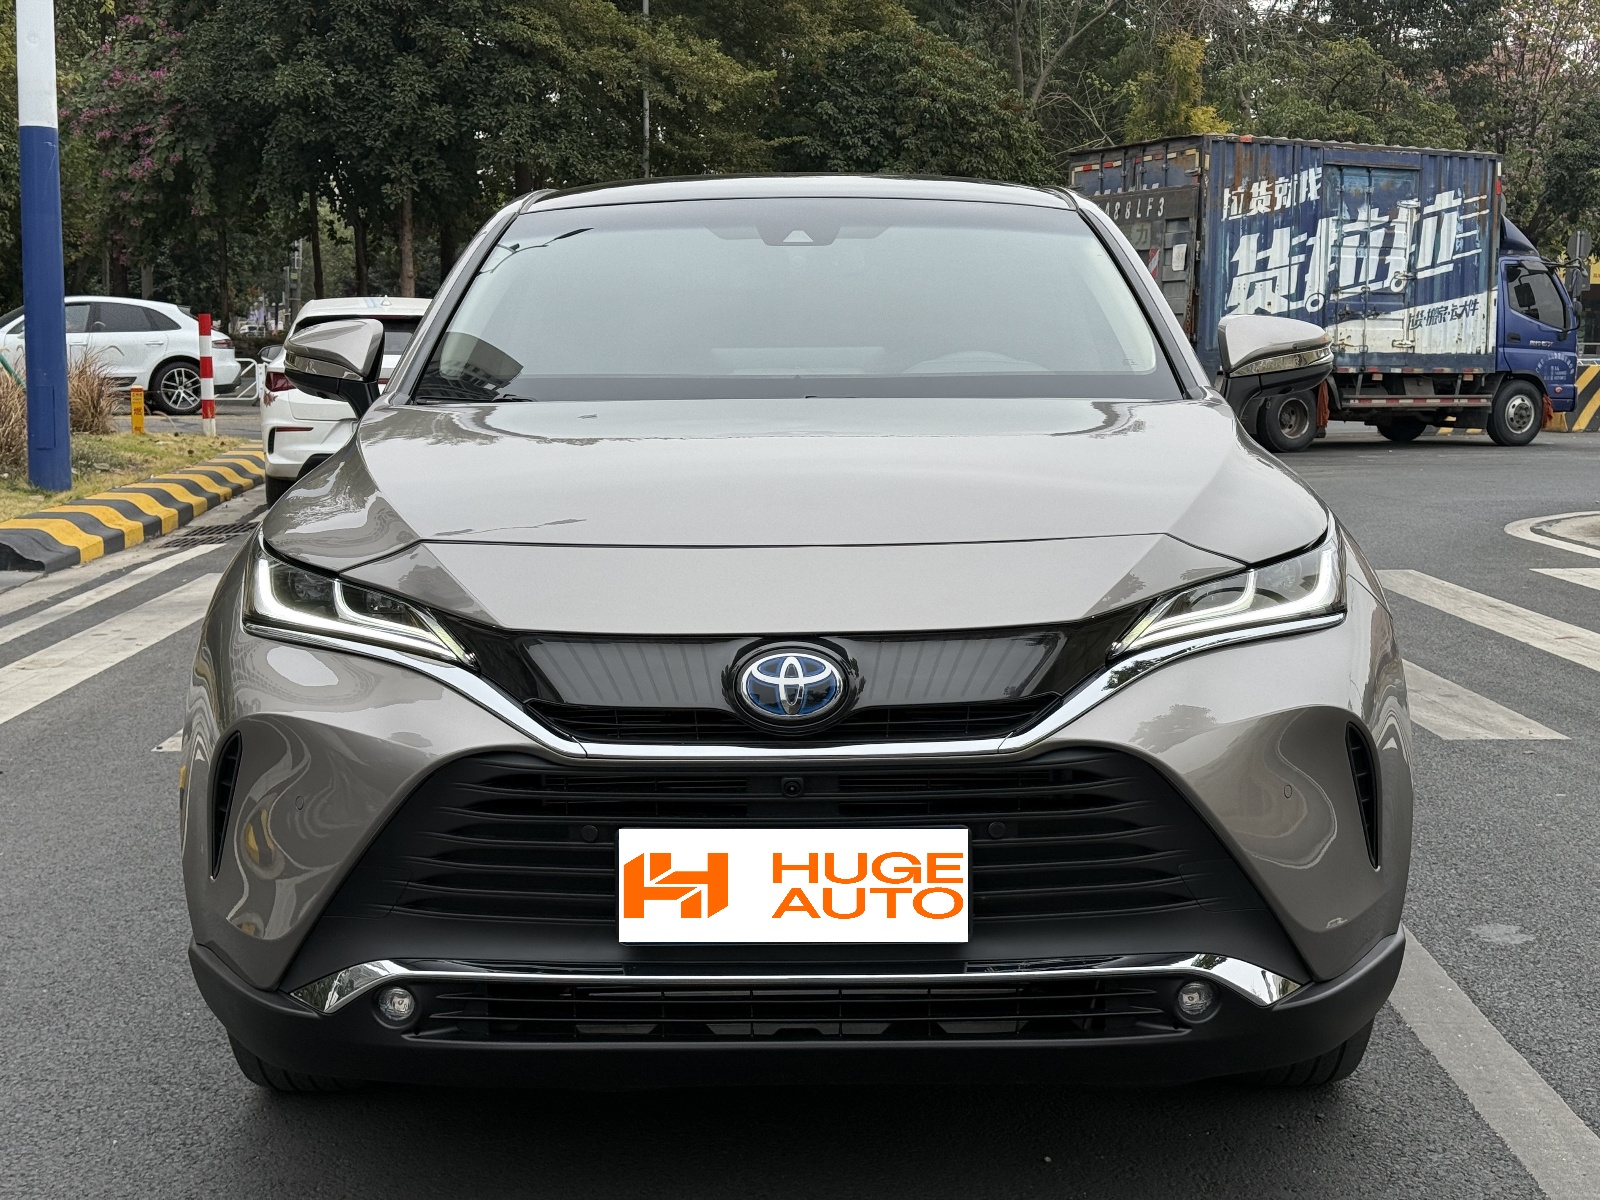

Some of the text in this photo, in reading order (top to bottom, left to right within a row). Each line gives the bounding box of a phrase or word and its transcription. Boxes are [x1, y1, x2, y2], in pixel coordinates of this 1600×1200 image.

[1097, 196, 1165, 221] A88LF3
[1221, 166, 1323, 222] 拉货就找
[1226, 188, 1464, 316] 货拉拉
